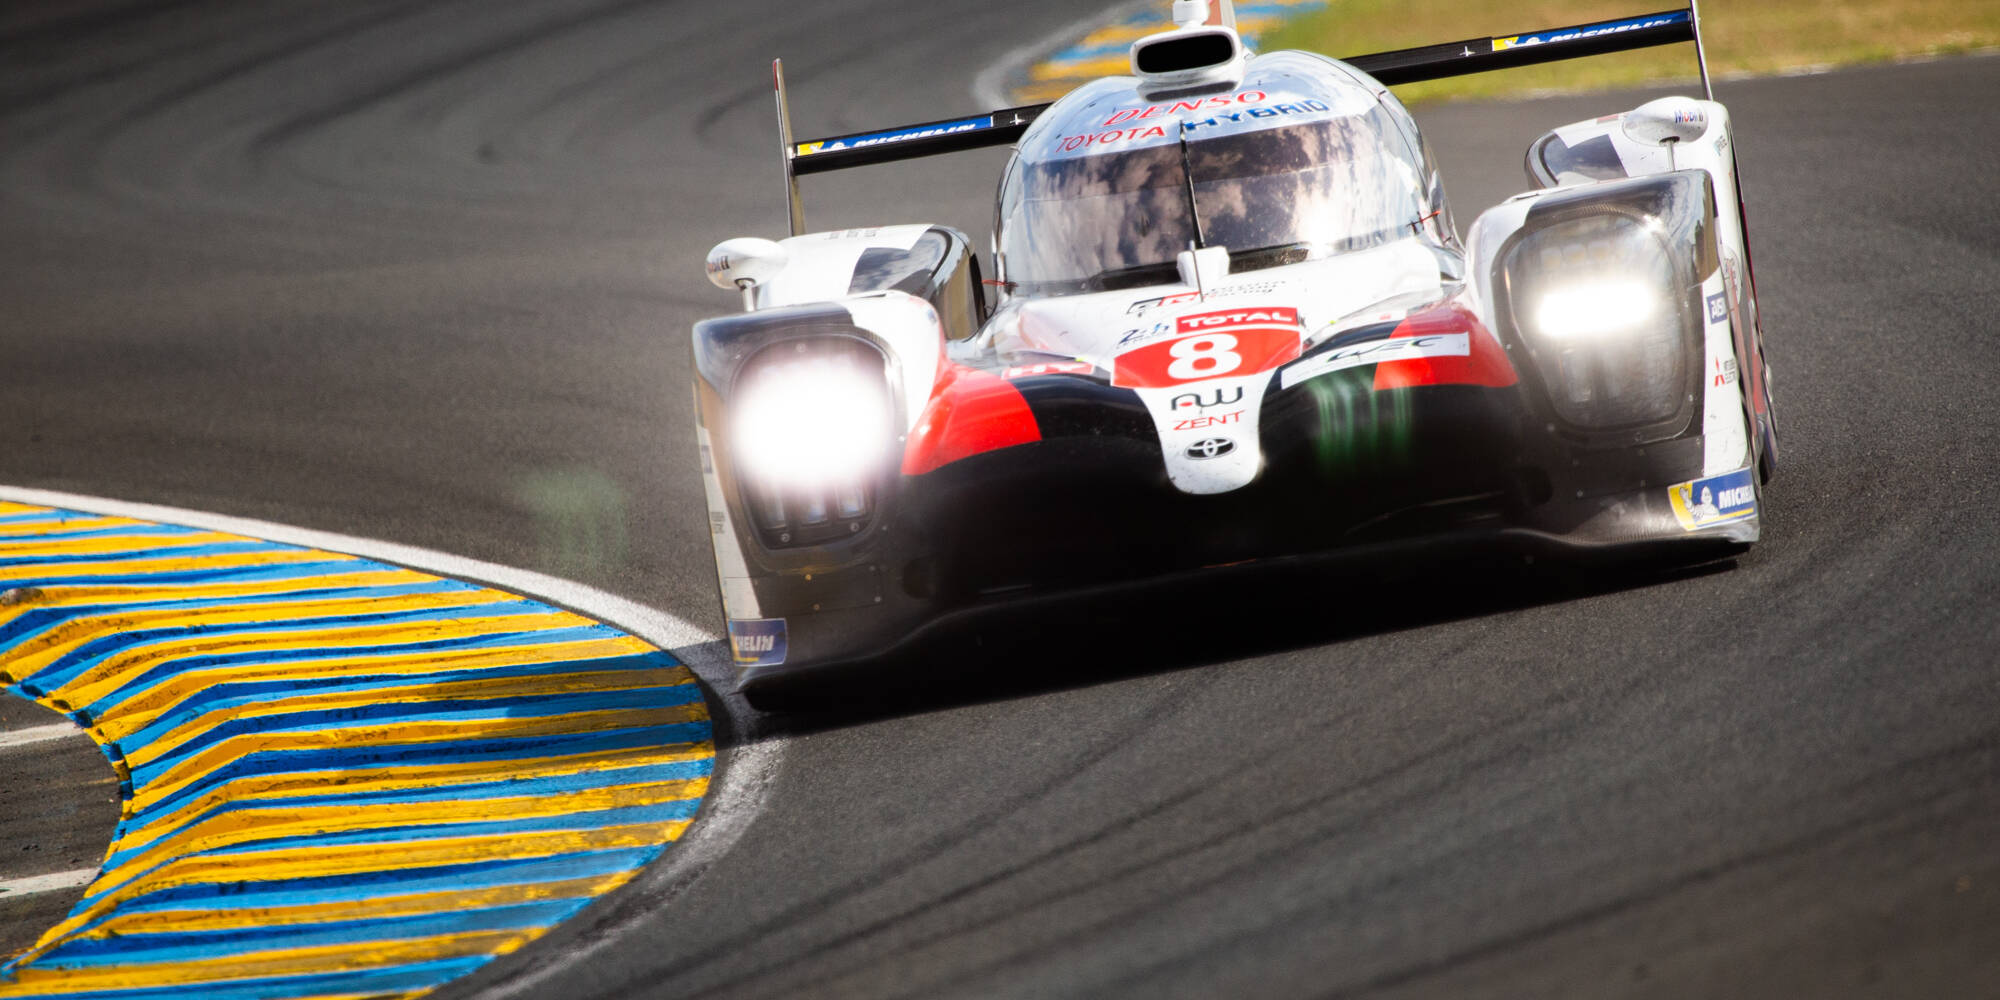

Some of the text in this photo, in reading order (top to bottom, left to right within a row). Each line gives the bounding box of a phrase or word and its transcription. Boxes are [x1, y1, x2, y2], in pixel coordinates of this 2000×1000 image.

[1103, 90, 1266, 126] DENSO
[1182, 99, 1331, 132] HYBRID
[1055, 125, 1166, 153] TOYOTA
[1181, 312, 1293, 328] TOTAL
[1166, 333, 1242, 379] 8
[1172, 409, 1247, 431] ZENT
